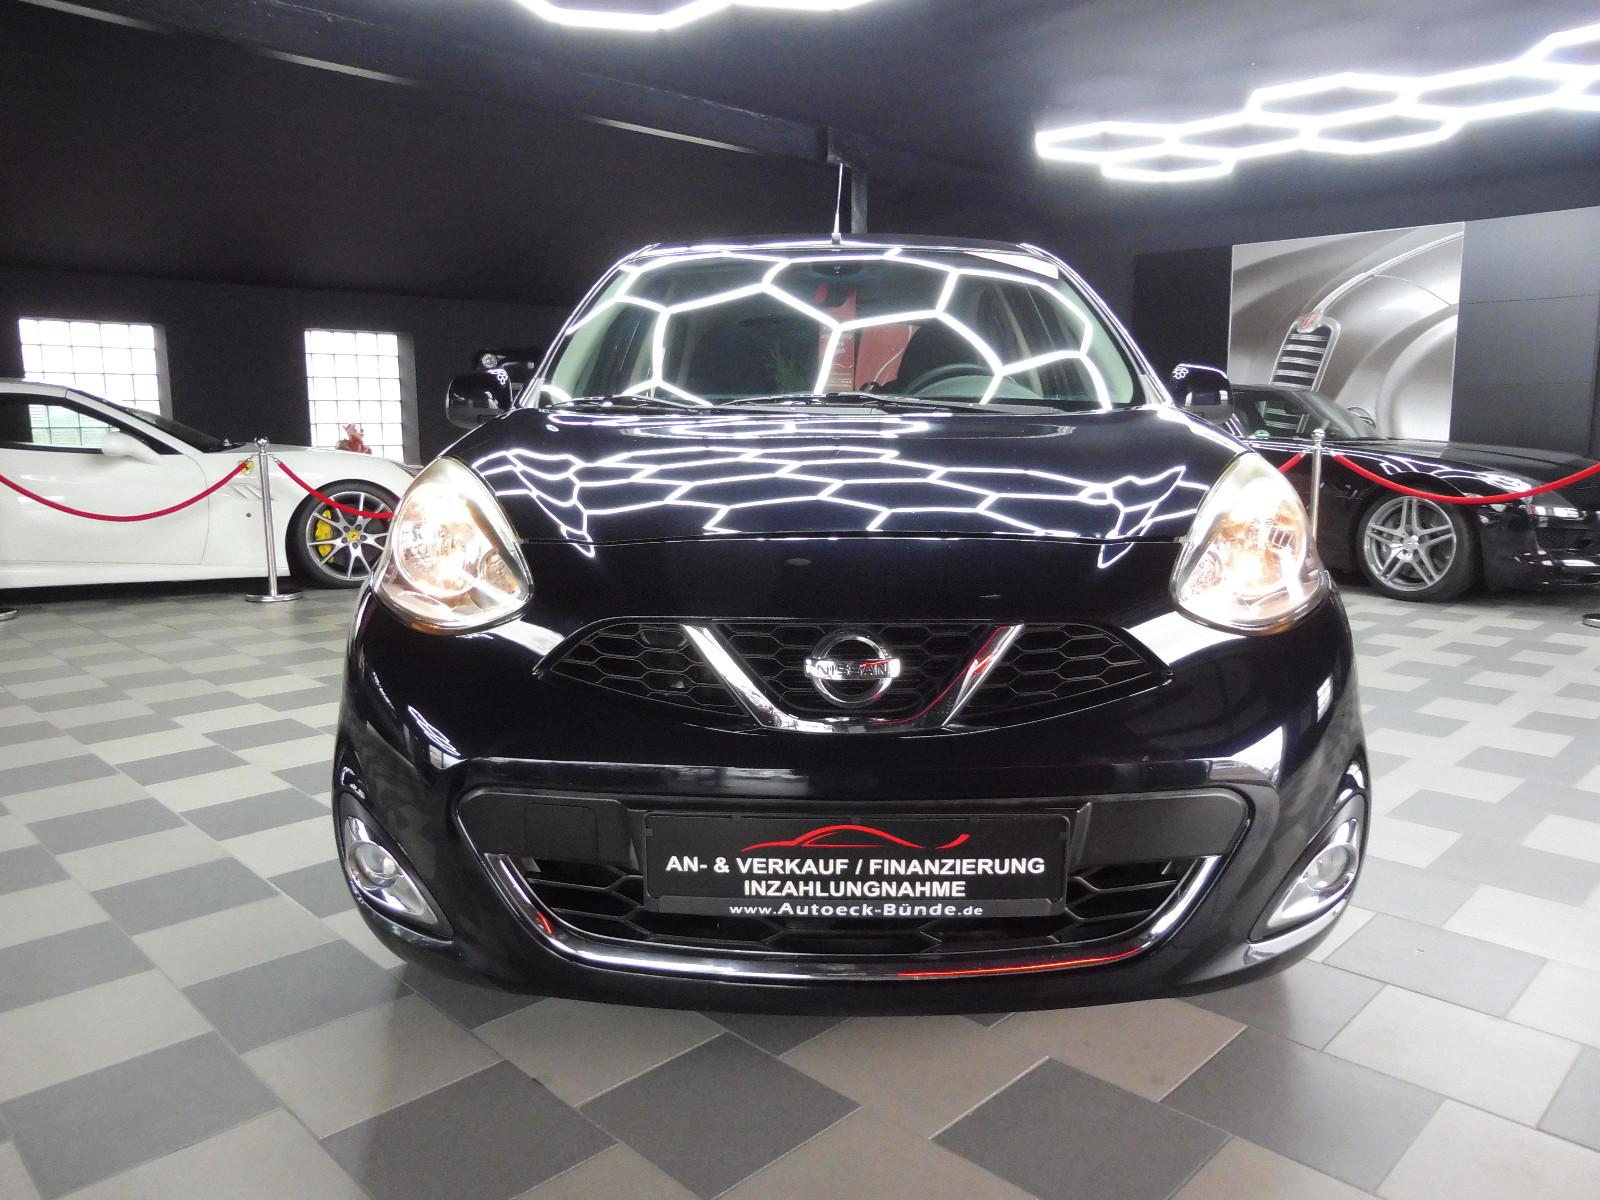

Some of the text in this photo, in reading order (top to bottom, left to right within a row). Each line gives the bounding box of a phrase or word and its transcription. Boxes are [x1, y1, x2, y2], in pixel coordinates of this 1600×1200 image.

[816, 663, 888, 677] NISSAN
[665, 855, 1045, 876] AN- & VERKAUF / FINANZIERUNG
[743, 879, 967, 898] INZAHLUNGNAHME
[728, 902, 984, 917] www.Autoeck-Bünde.de
